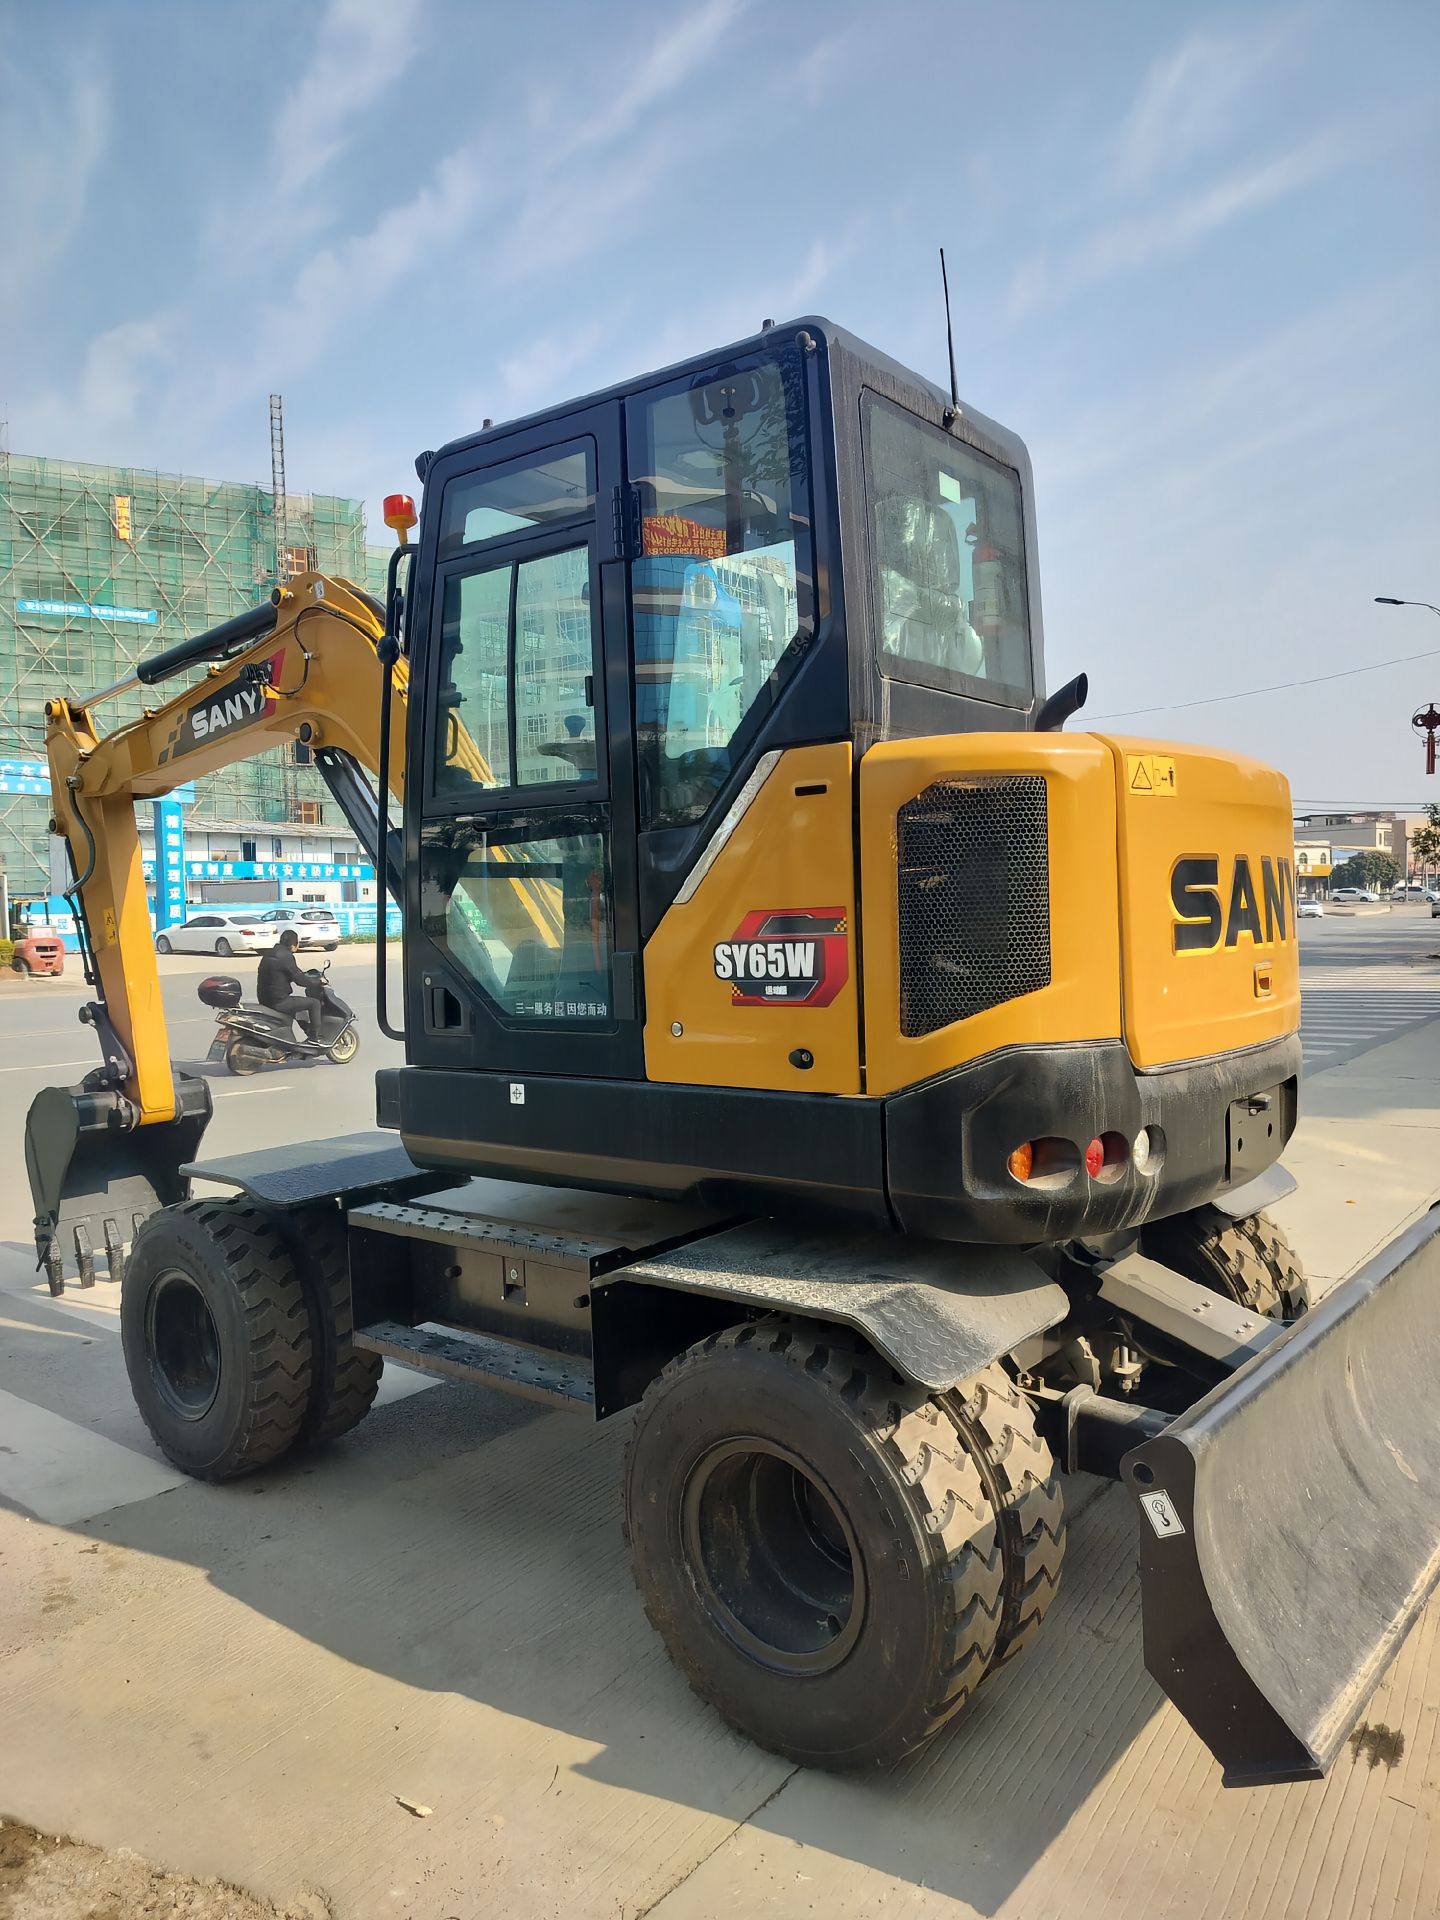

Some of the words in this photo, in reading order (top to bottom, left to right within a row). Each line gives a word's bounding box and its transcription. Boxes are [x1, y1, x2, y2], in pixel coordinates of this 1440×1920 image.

[191, 687, 256, 739] SANY
[715, 942, 815, 979] SY65W
[515, 1002, 553, 1015] 三一服务
[567, 1002, 607, 1016] 因您而动
